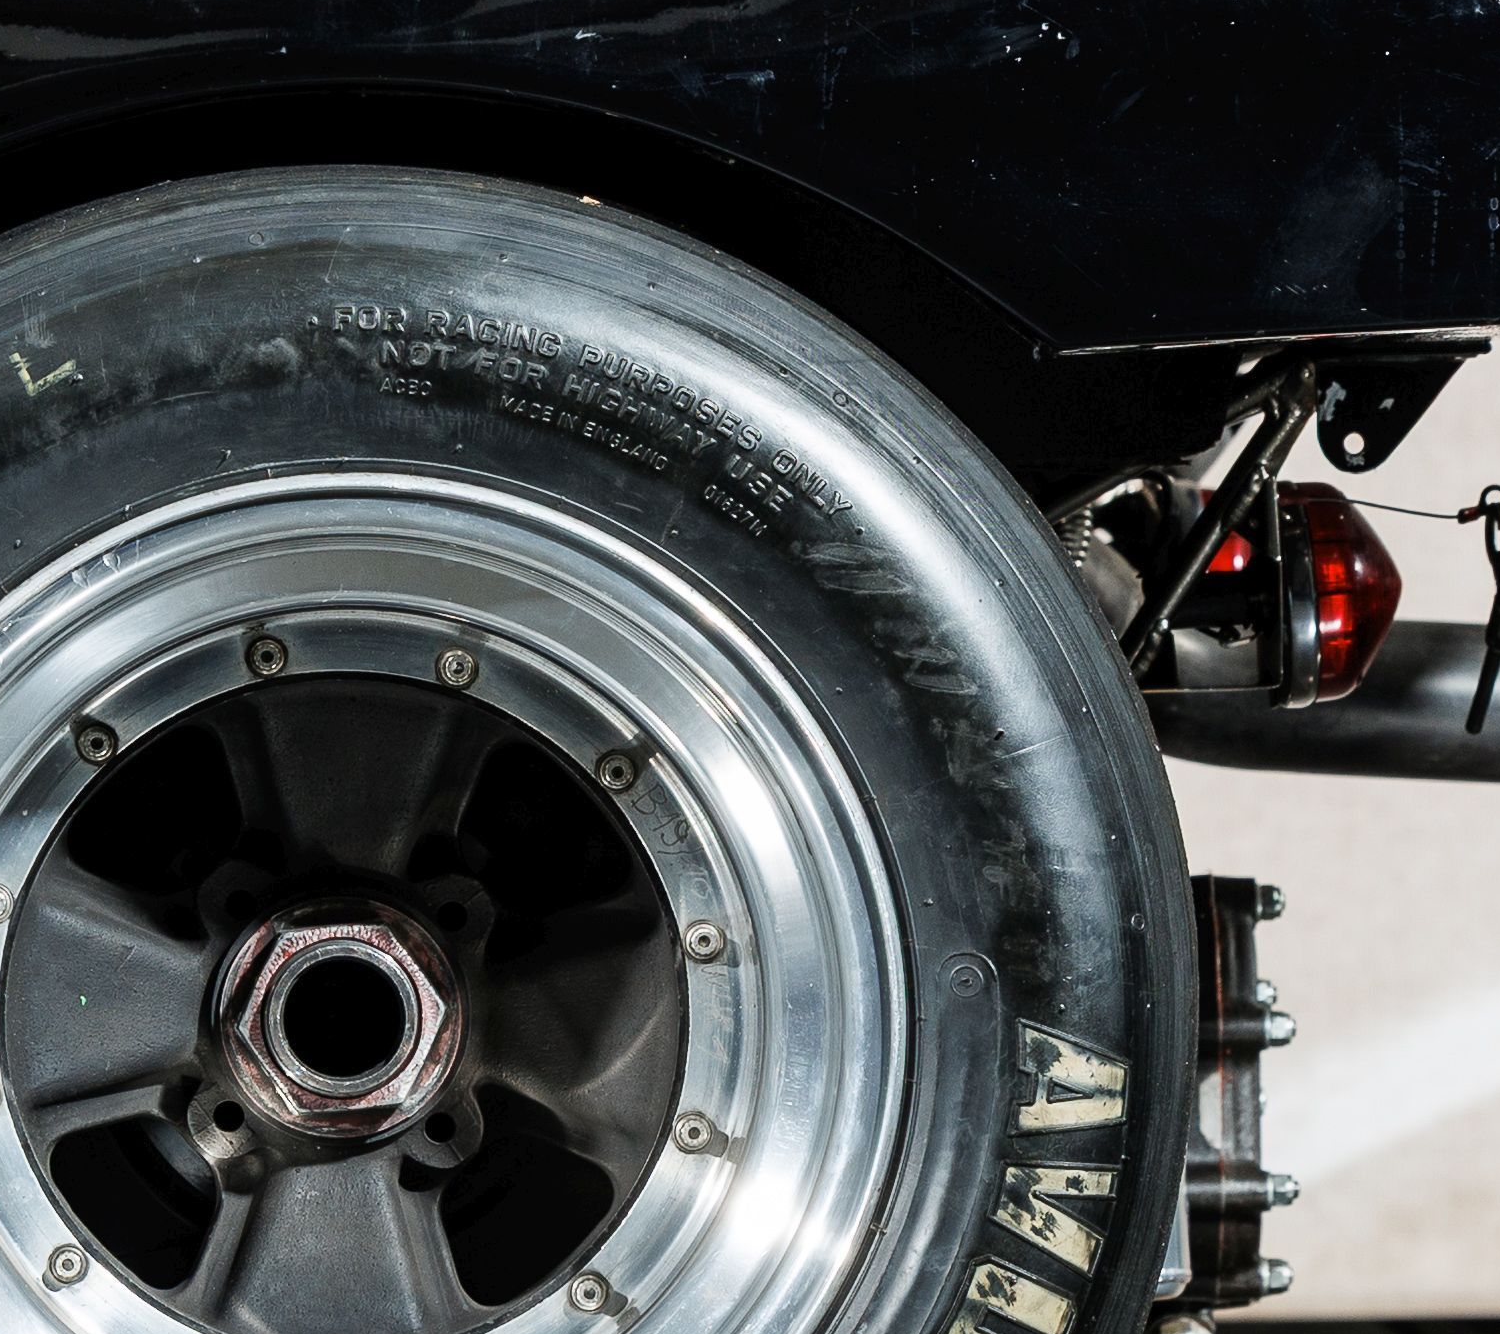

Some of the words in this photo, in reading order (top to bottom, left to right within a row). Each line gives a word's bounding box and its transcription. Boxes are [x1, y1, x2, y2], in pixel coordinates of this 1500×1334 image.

[332, 305, 407, 333] FOR
[423, 309, 562, 359] RACING
[577, 343, 764, 453] PURPOSES
[771, 447, 854, 518] ONLY
[377, 339, 456, 371] NOT
[473, 348, 549, 390] FOR
[560, 372, 718, 458] HIGHWAY
[725, 454, 794, 513] USE
[557, 411, 579, 434] IN
[583, 420, 670, 471] ENGLAND
